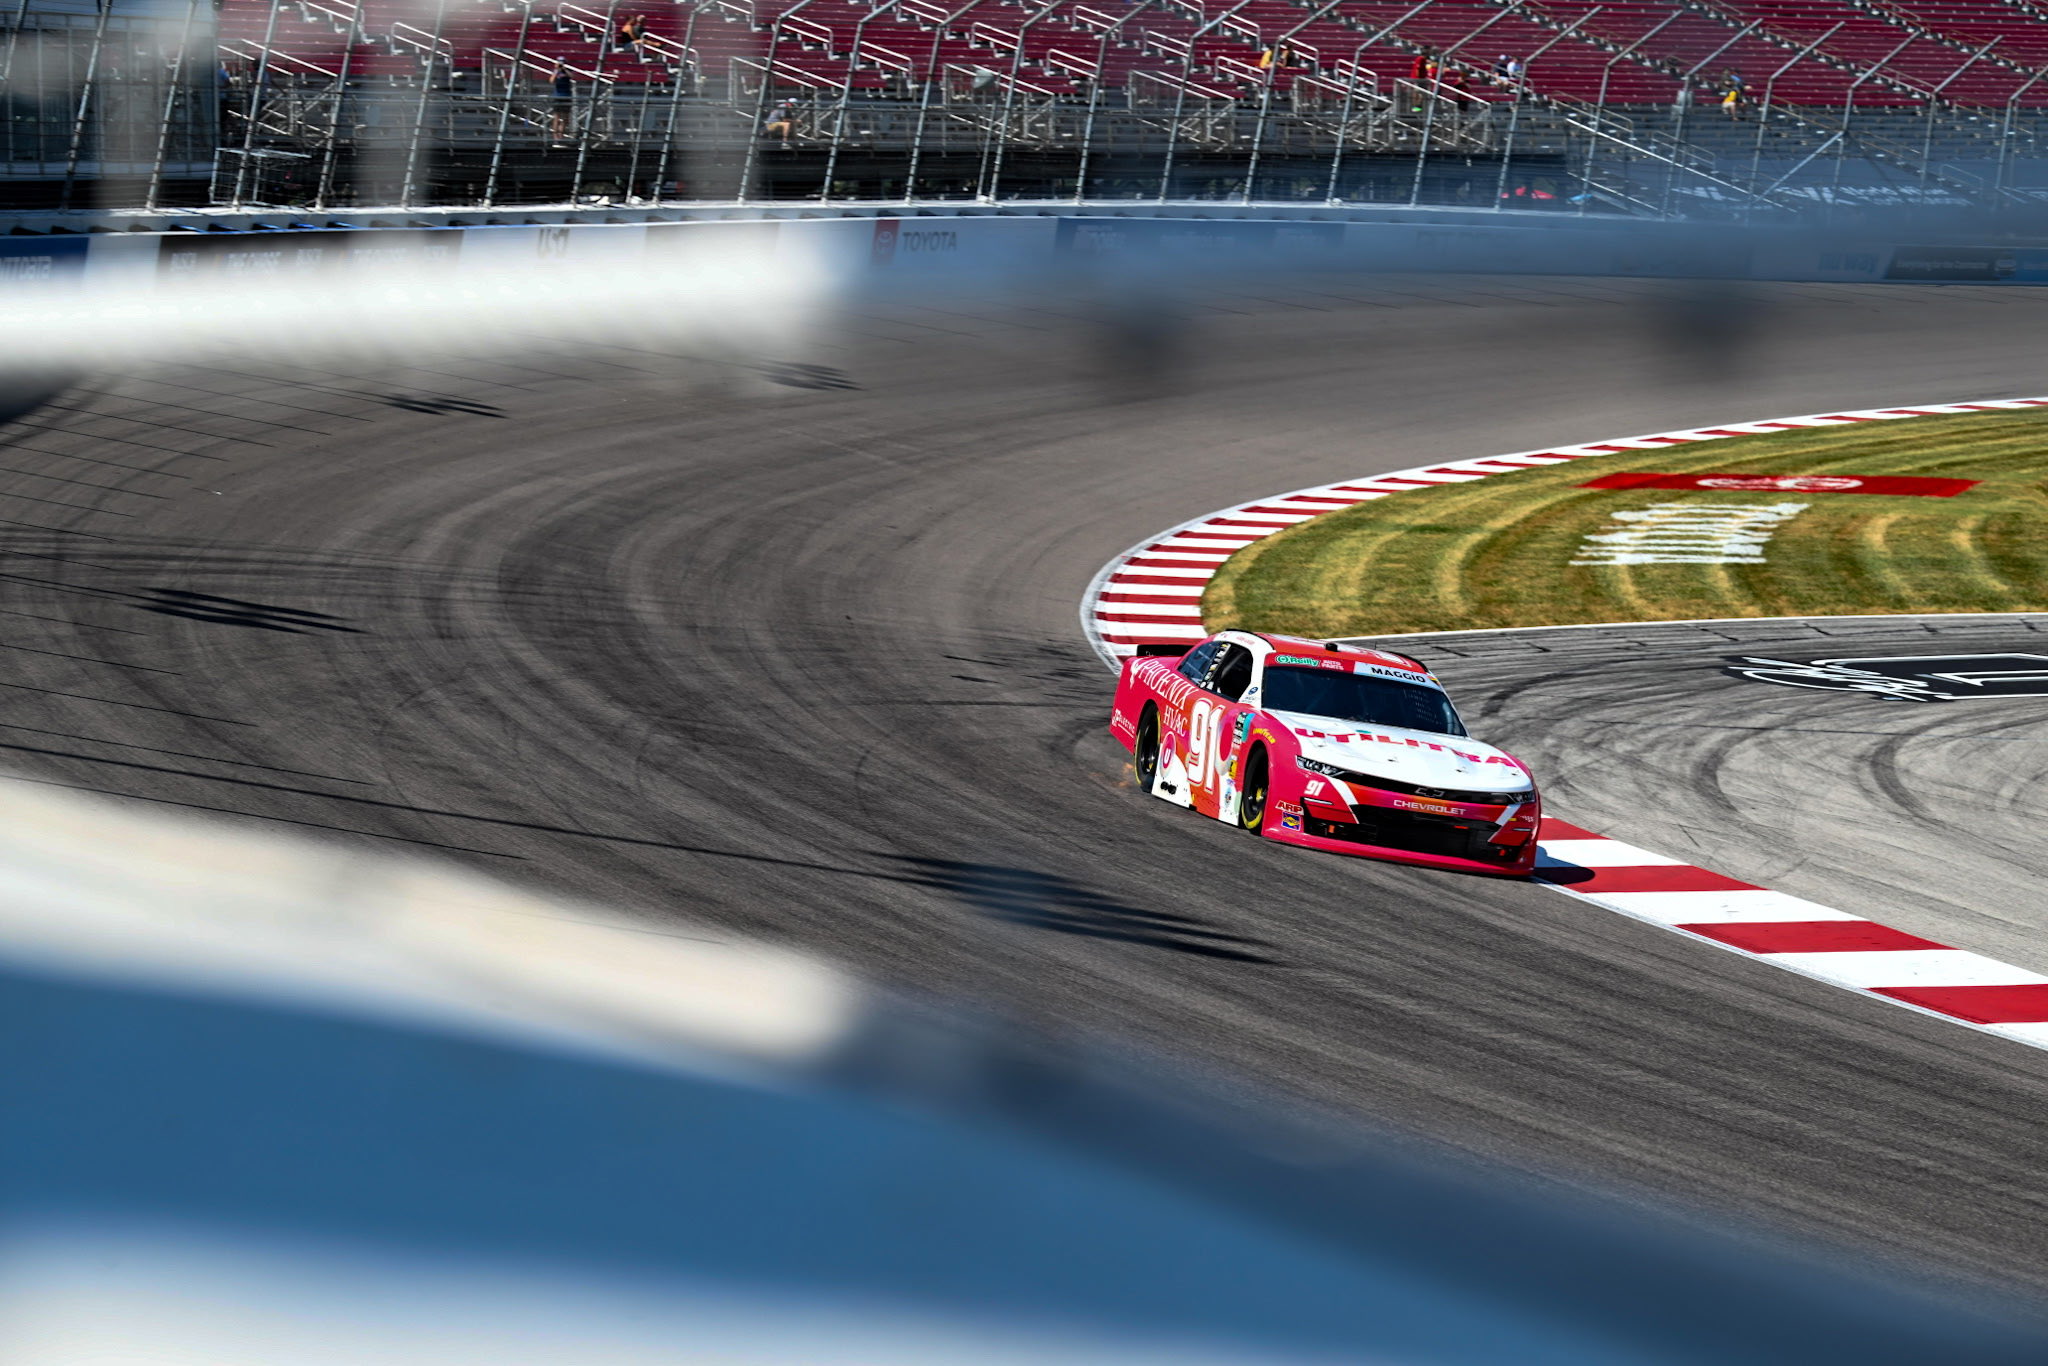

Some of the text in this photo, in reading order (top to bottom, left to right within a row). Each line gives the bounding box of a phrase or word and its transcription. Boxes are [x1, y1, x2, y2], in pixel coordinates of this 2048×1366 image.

[902, 231, 957, 251] TOYOTA
[1371, 667, 1426, 683] MAGGIO
[1138, 660, 1199, 711] PHOENIX
[1163, 705, 1188, 737] HVAC
[1186, 697, 1226, 795] 91
[1303, 780, 1326, 796] 91
[1276, 801, 1303, 813] ARP
[1393, 799, 1466, 816] CHEVROLET
